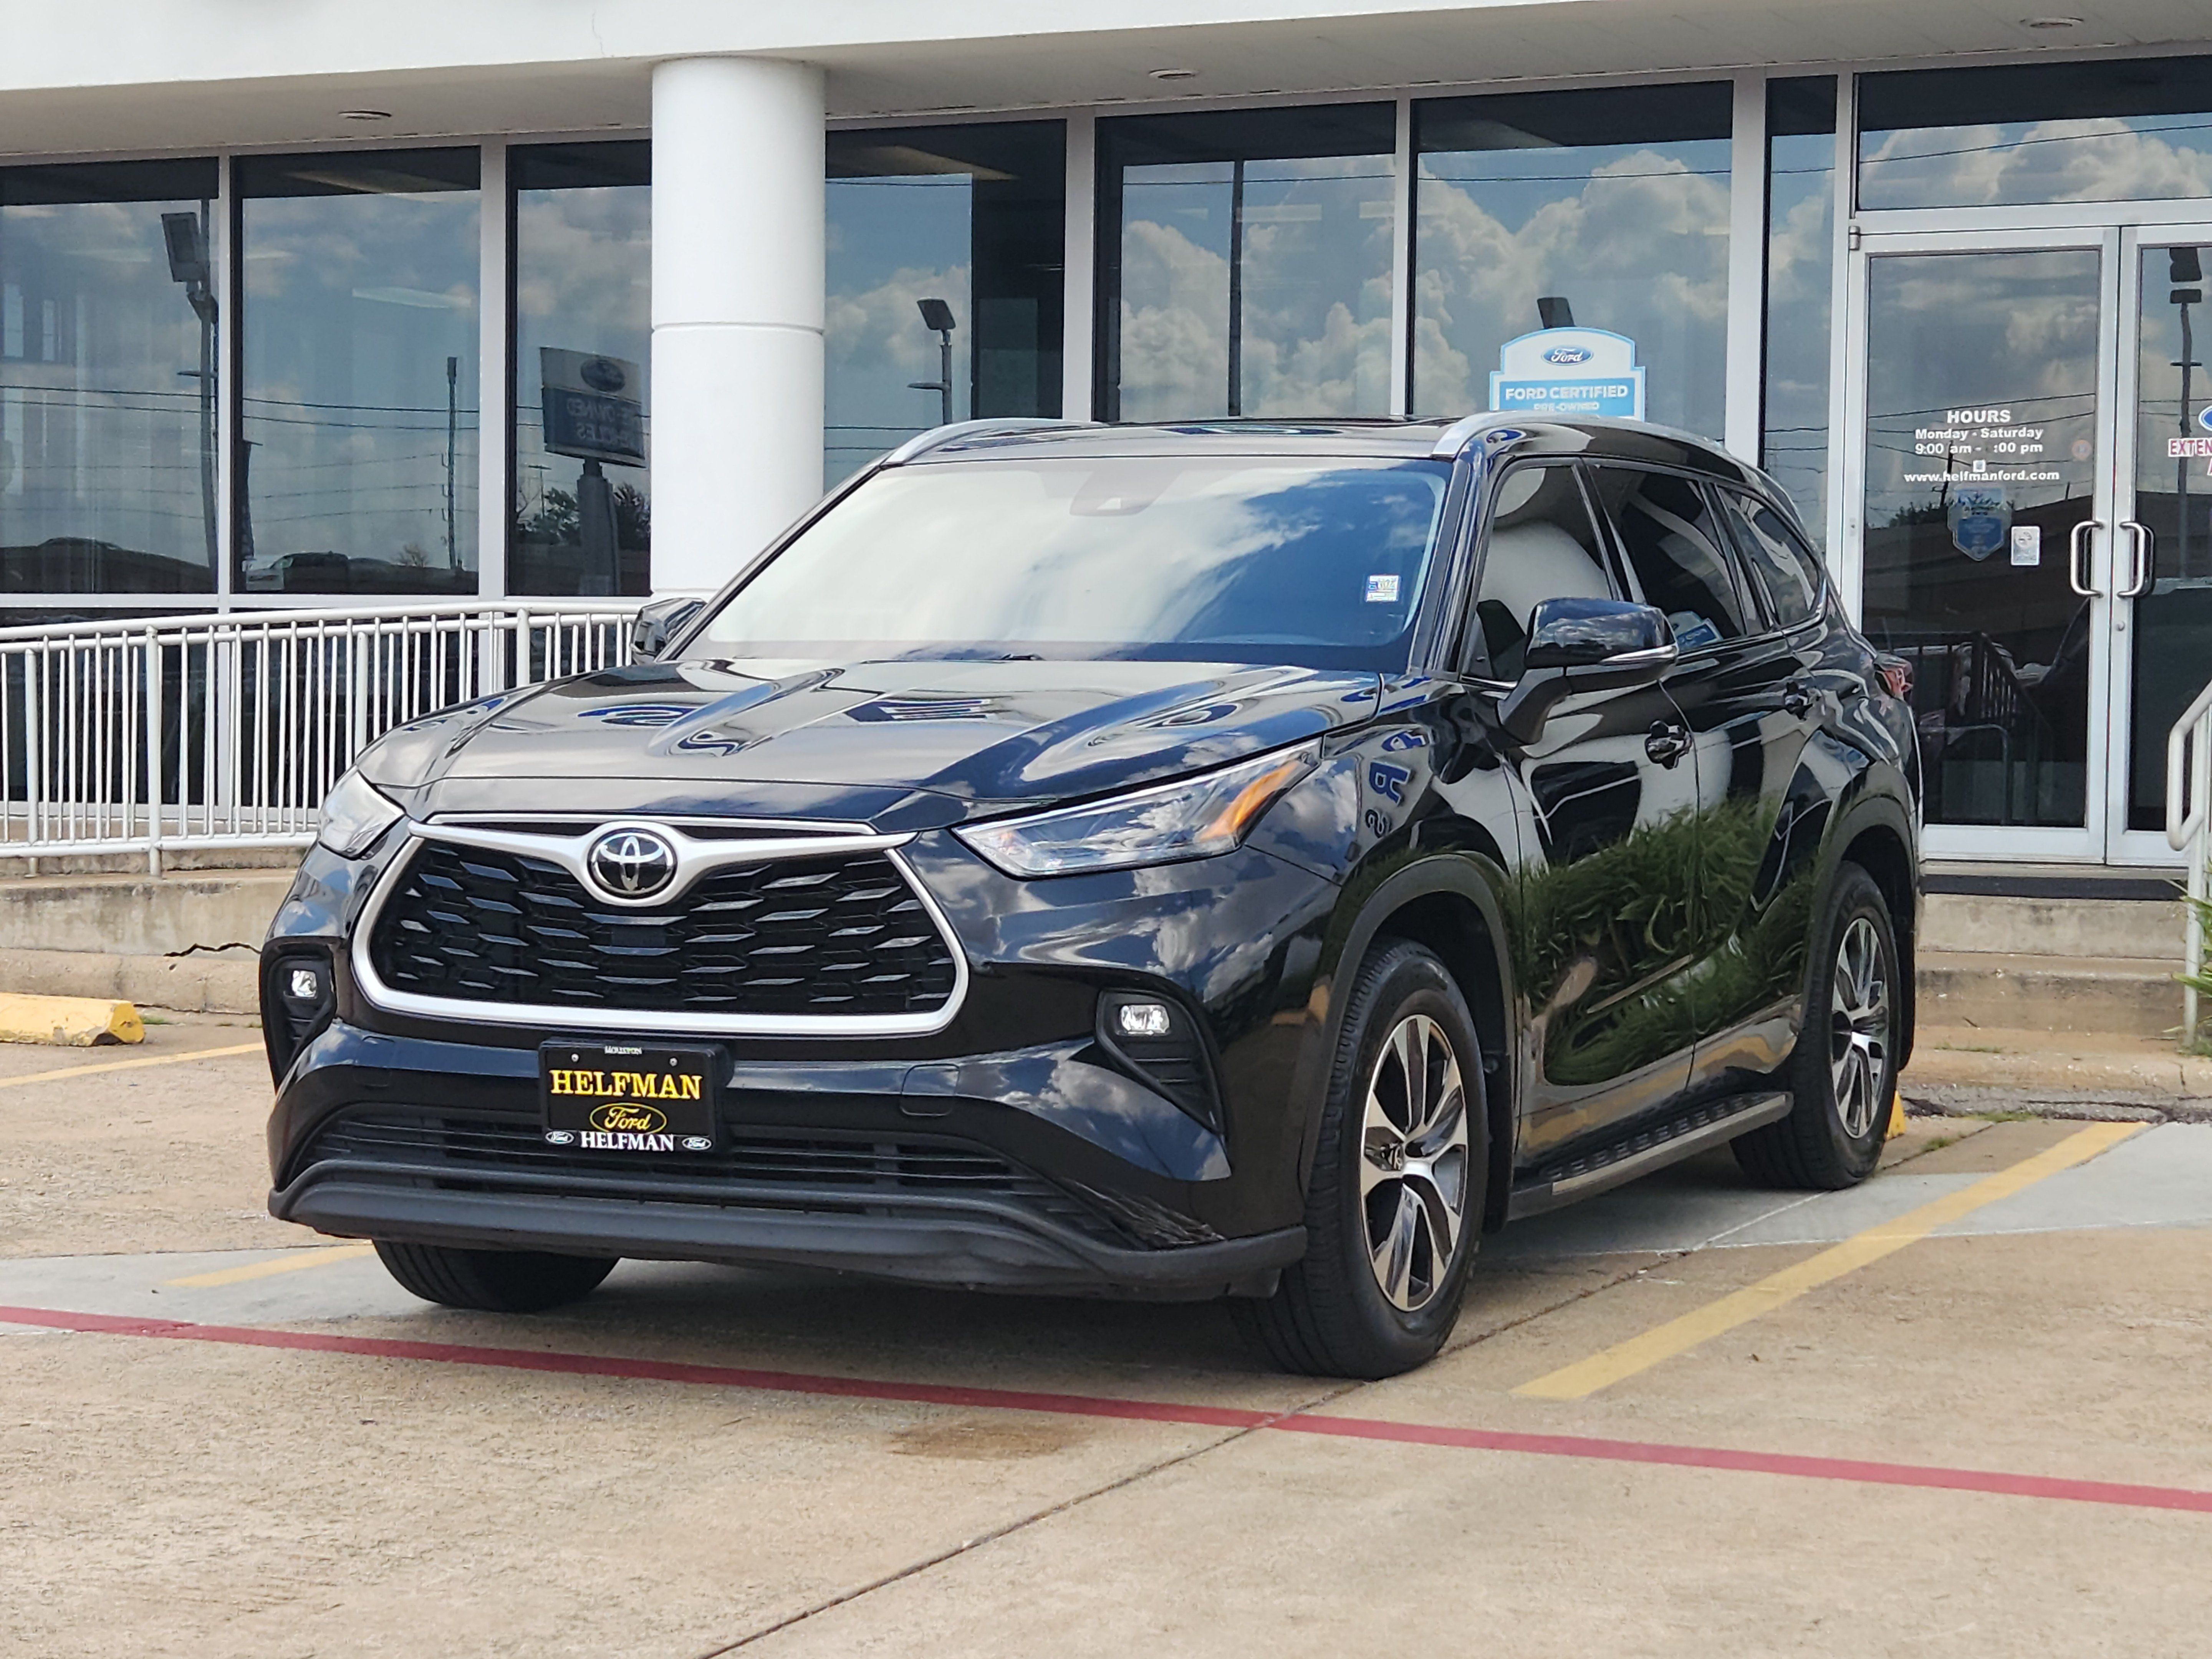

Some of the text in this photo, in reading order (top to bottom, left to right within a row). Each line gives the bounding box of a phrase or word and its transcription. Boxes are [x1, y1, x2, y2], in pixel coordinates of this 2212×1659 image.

[1551, 348, 1583, 363] Ford
[1505, 385, 1628, 400] FORD CERTIFIED
[1947, 410, 2011, 423] HOURS
[1915, 428, 1968, 441] Monday
[1980, 427, 2043, 440] Saturday
[1915, 443, 1944, 454] 9:00
[1950, 444, 1971, 454] am
[2021, 444, 2043, 454] pm
[1904, 470, 2060, 482] www.helfmanford.com
[548, 1070, 703, 1100] HELFMAN
[604, 1106, 652, 1130] Ford
[579, 1132, 674, 1152] HELFMAN
